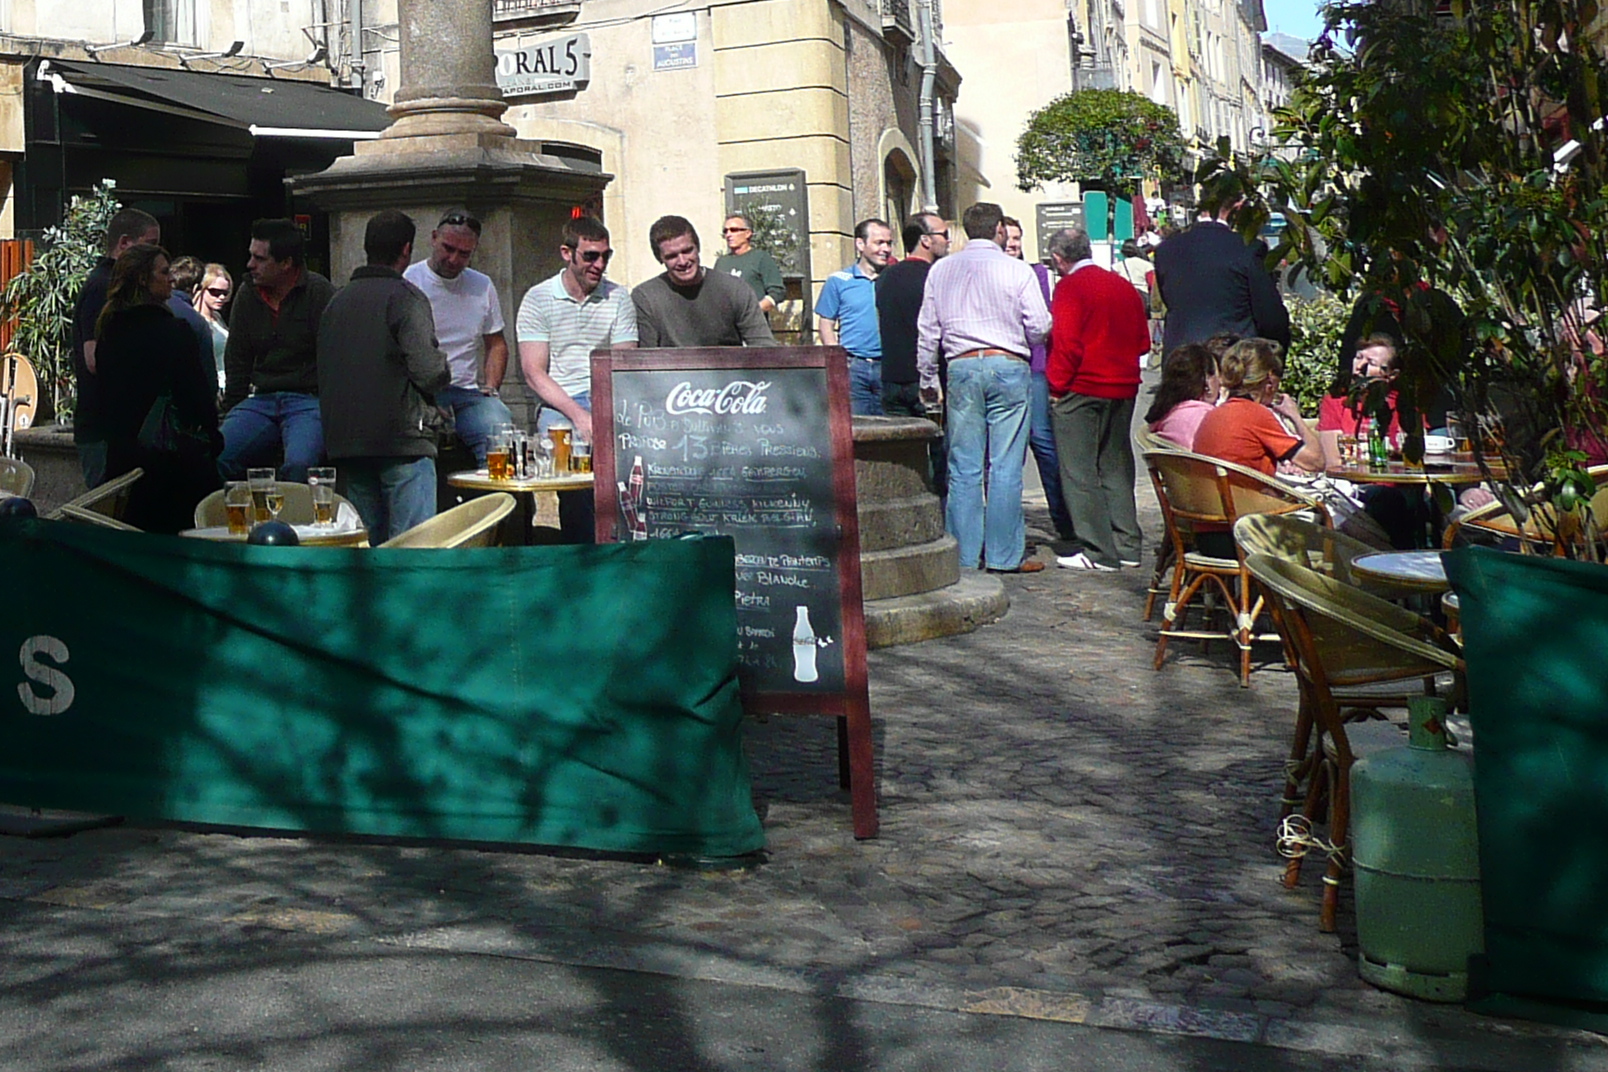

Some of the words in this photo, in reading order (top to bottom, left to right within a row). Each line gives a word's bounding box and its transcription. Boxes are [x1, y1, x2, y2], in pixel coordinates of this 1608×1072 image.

[493, 45, 561, 77] ORAL
[564, 38, 578, 76] 5
[666, 381, 772, 414] Coca-Cola
[671, 434, 708, 462] 13
